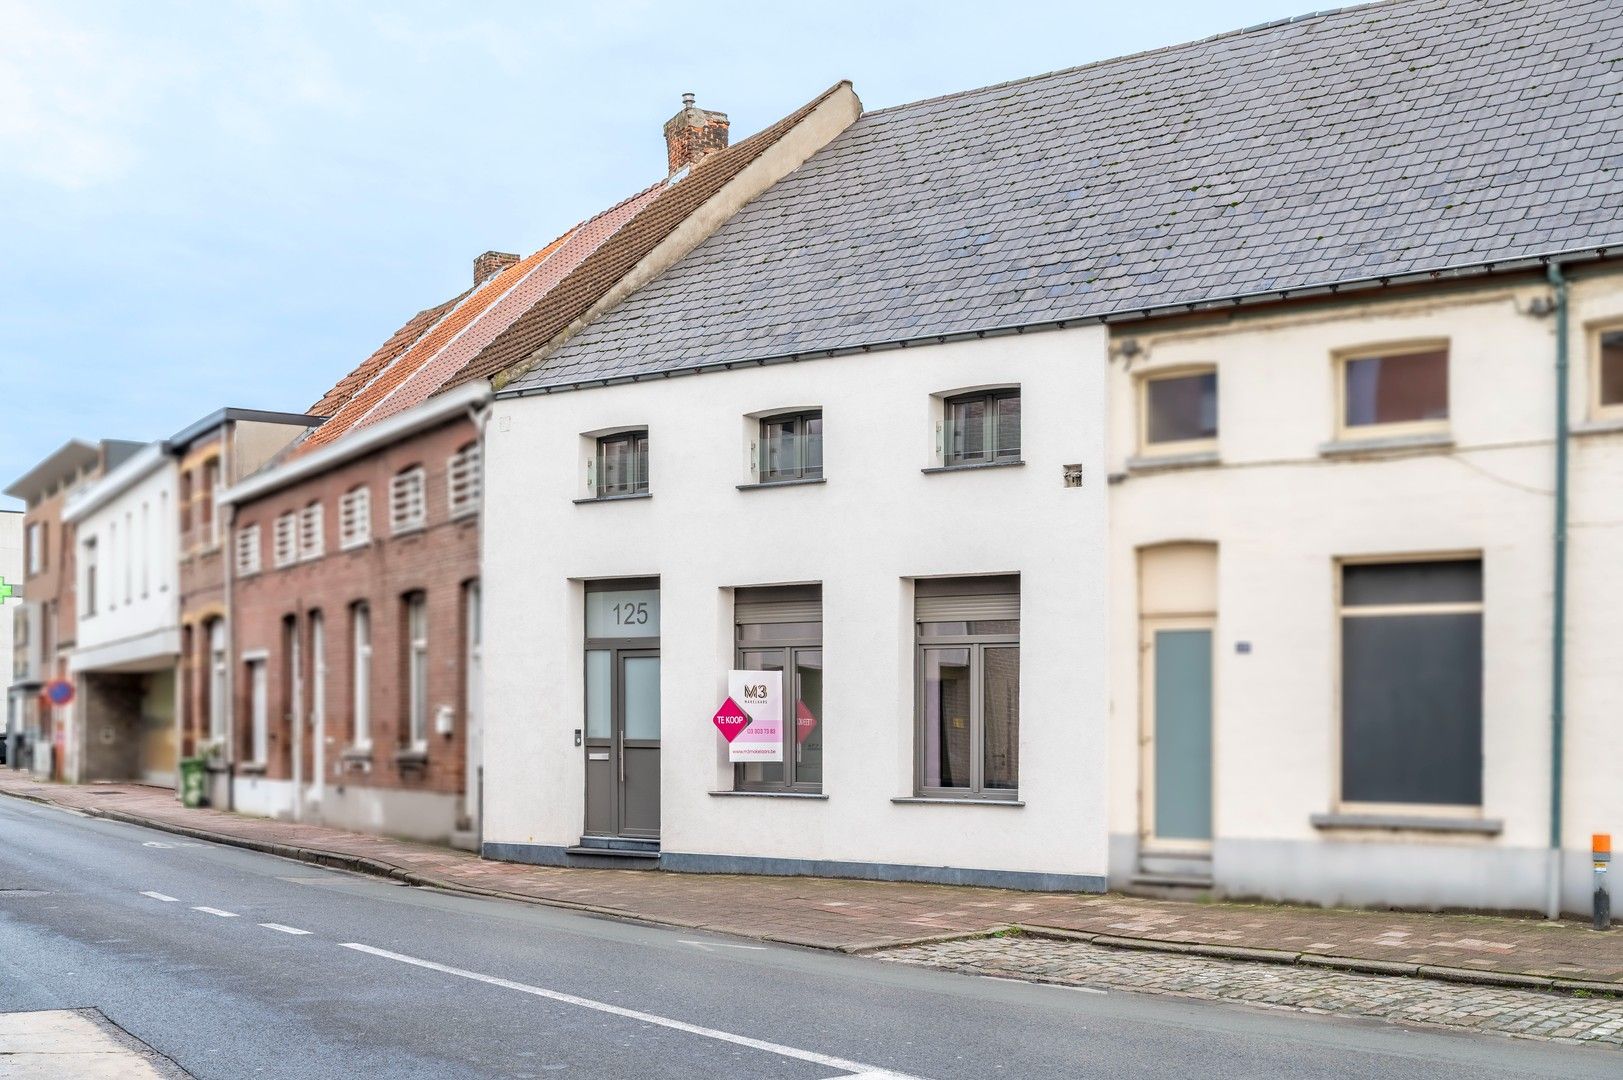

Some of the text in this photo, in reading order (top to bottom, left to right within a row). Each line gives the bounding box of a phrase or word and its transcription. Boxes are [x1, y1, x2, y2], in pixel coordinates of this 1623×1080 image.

[613, 602, 648, 625] 125
[744, 684, 768, 699] M3
[717, 716, 743, 724] TE KOOP
